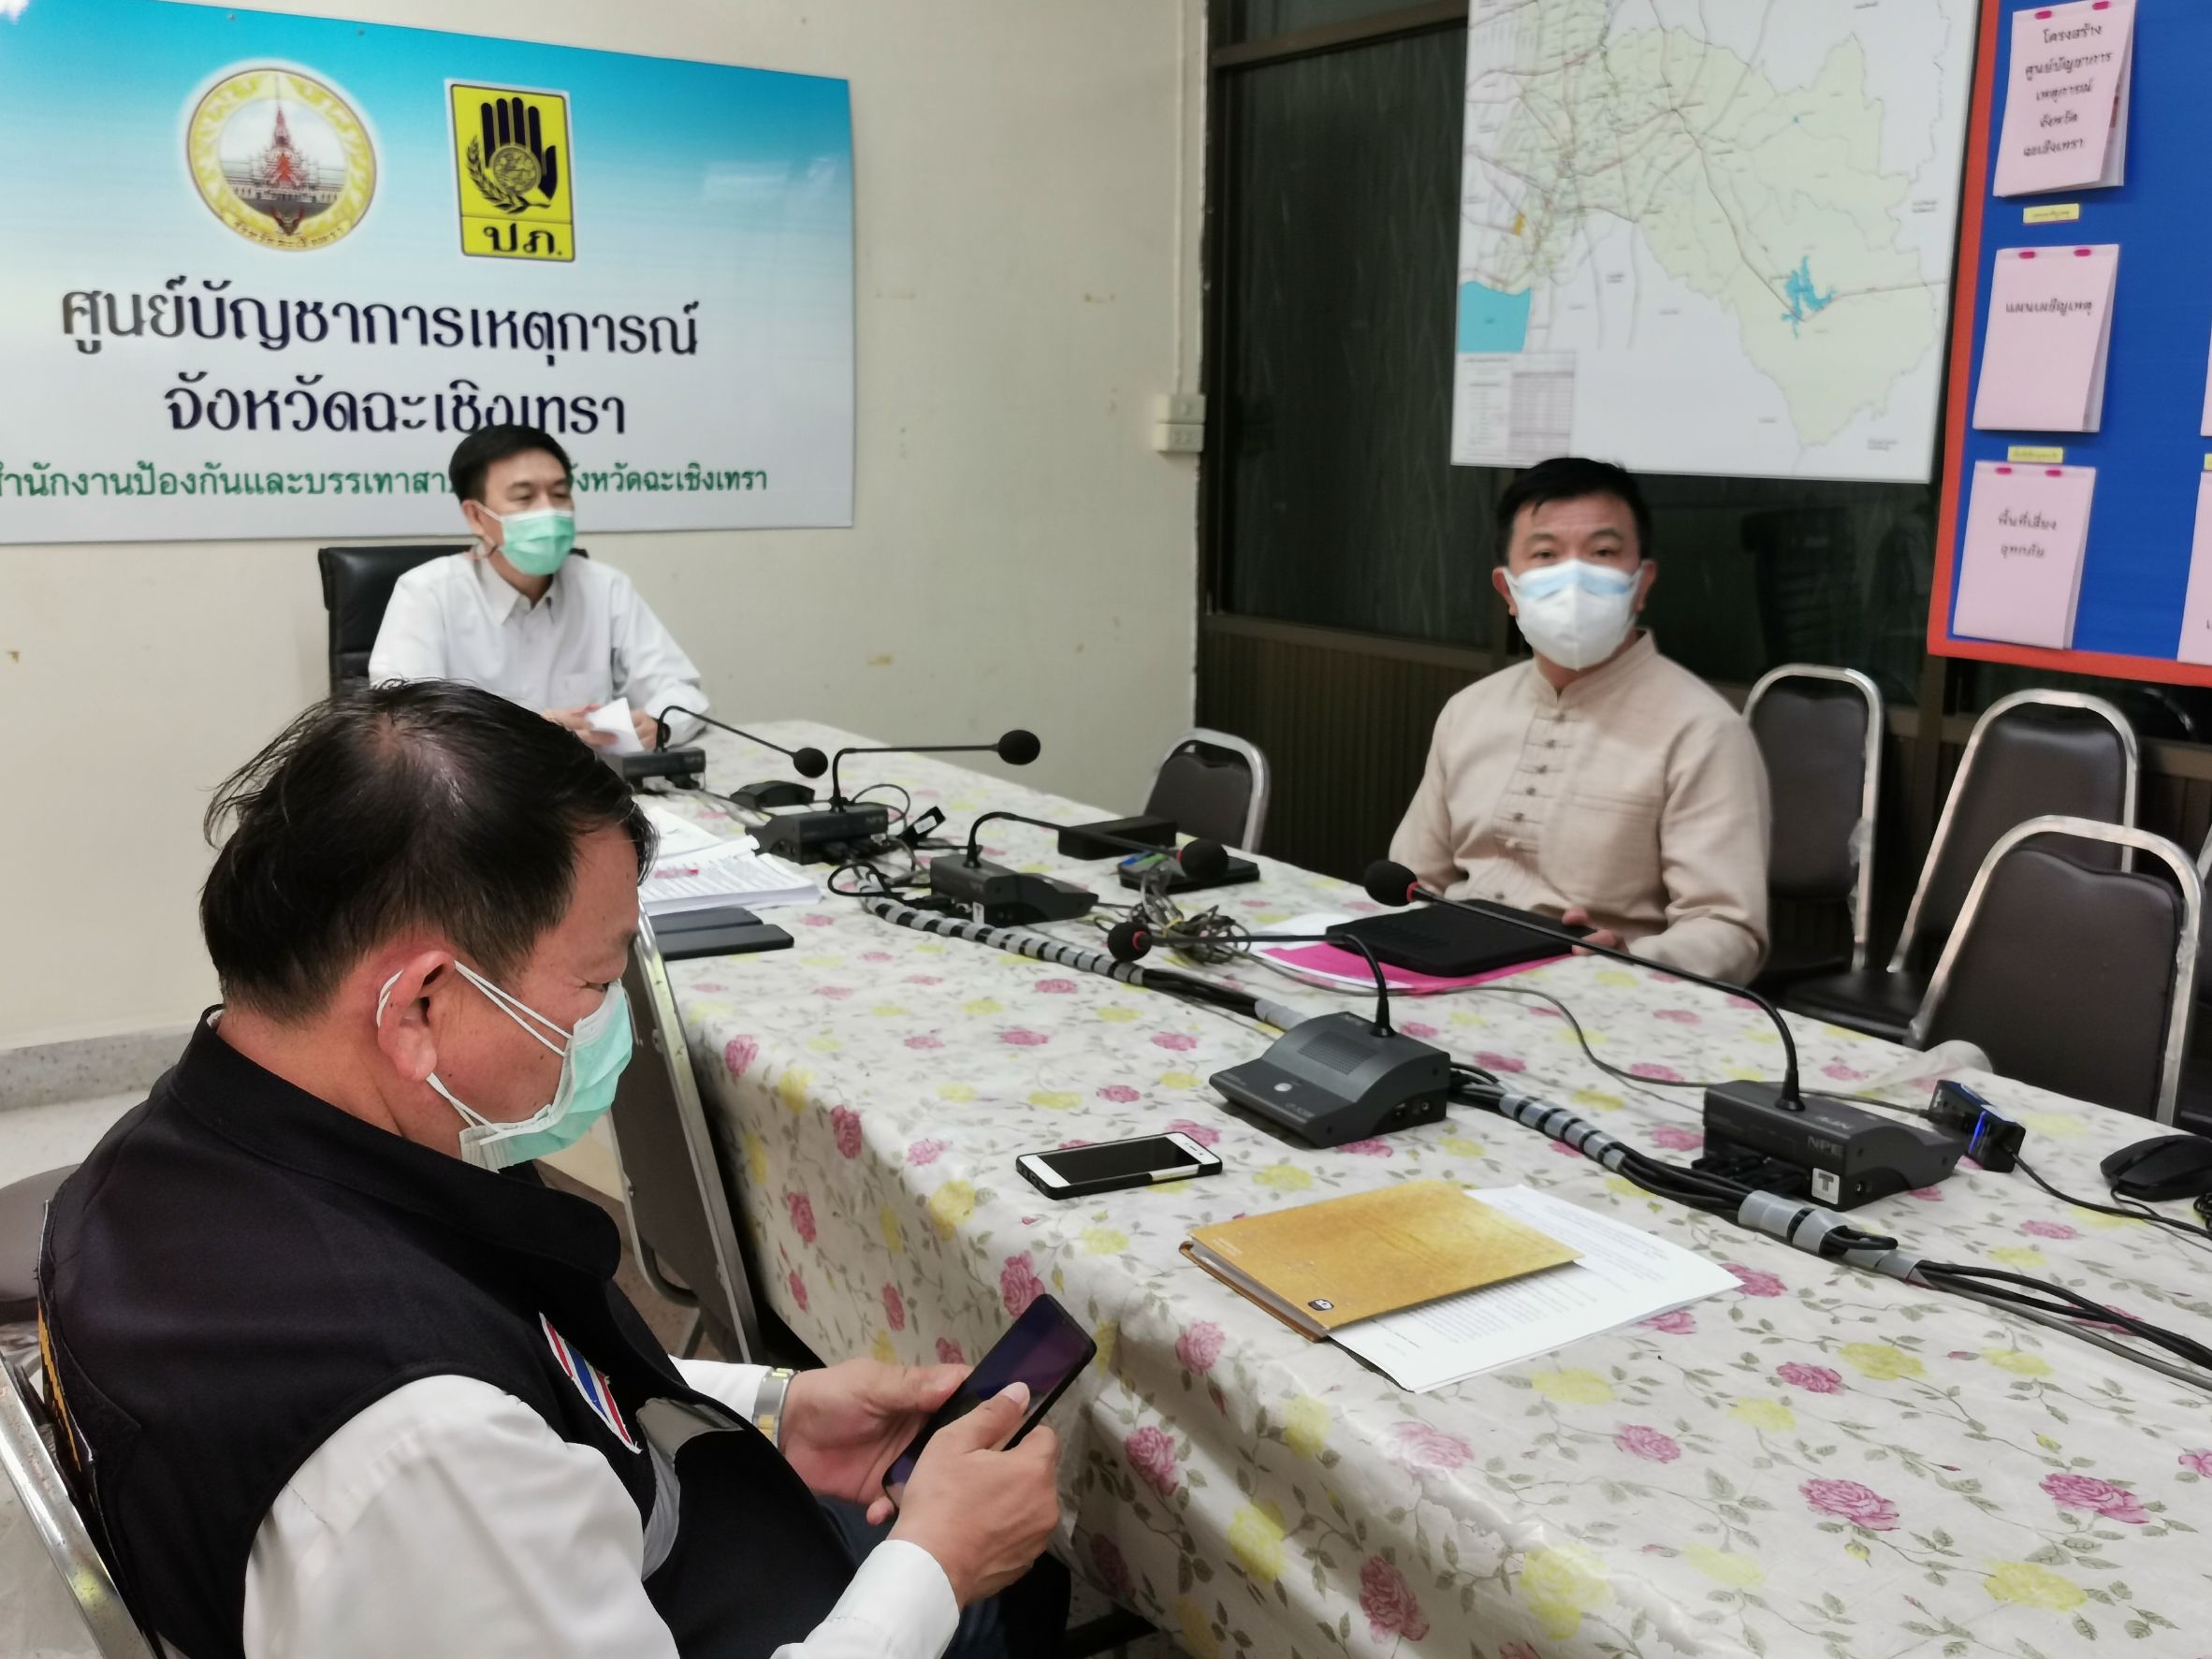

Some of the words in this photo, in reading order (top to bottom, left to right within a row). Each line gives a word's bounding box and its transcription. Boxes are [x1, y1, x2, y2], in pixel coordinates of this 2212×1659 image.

[2043, 22, 2103, 43] โครงสร้าง
[482, 222, 562, 257] ปภ.
[62, 274, 700, 367] ศูนย์บัญชาการเหตุการณ์
[164, 371, 625, 434] จังหวัดฉะเชิงเทรา
[1818, 1172, 1834, 1192] T
